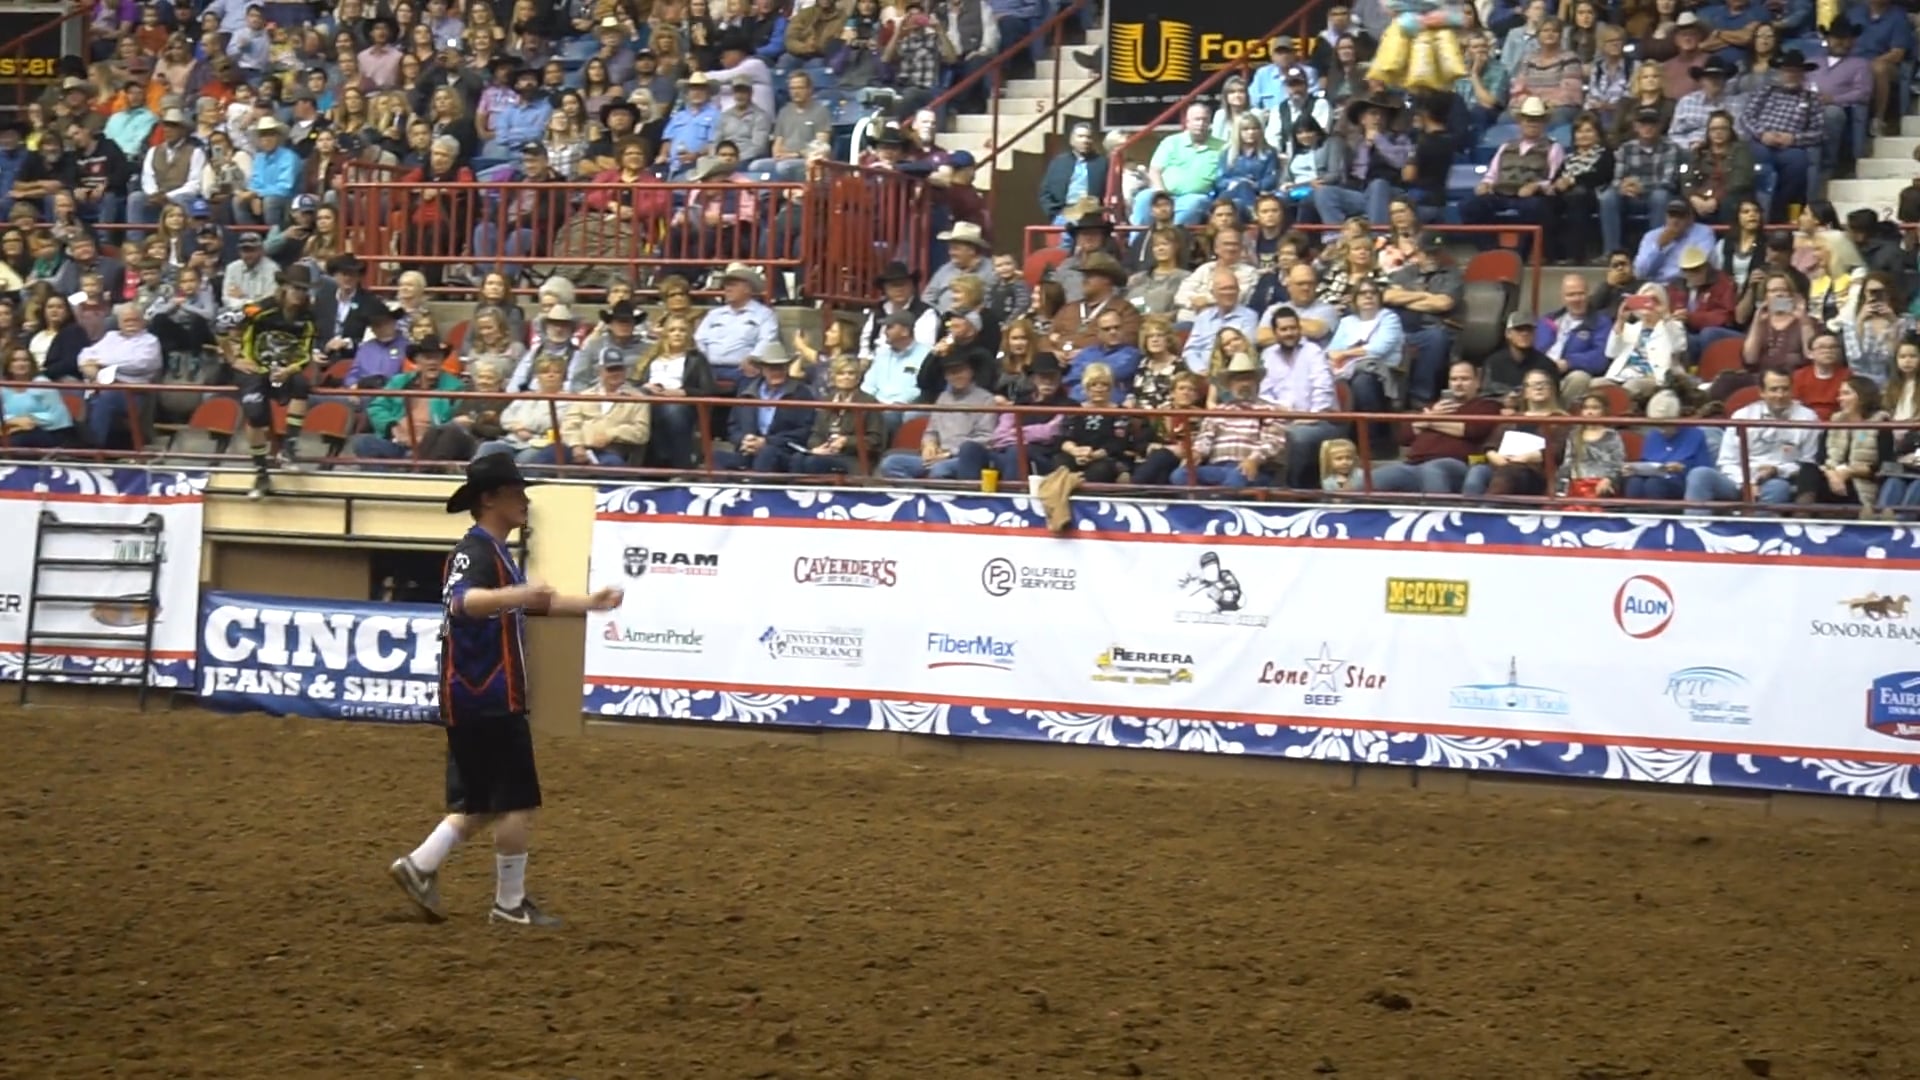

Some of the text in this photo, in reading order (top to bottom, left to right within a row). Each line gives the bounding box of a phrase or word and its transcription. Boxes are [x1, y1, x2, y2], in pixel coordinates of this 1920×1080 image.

[651, 552, 718, 566] RAM
[794, 556, 897, 587] CAVENDER'S
[1020, 566, 1077, 579] OILFIELD
[1020, 578, 1076, 591] SERVICES
[624, 627, 703, 646] AmeriPride
[1810, 620, 1883, 638] SONORA
[785, 634, 863, 647] INVESTMENT
[928, 632, 1017, 657] FiberMax
[791, 646, 863, 658] INSURANCE
[1113, 647, 1194, 664] HERRERA
[201, 666, 302, 696] JEANS
[307, 674, 336, 699] &
[1258, 661, 1309, 686] Lone
[1344, 665, 1387, 690] Star
[1304, 694, 1342, 706] BEEF
